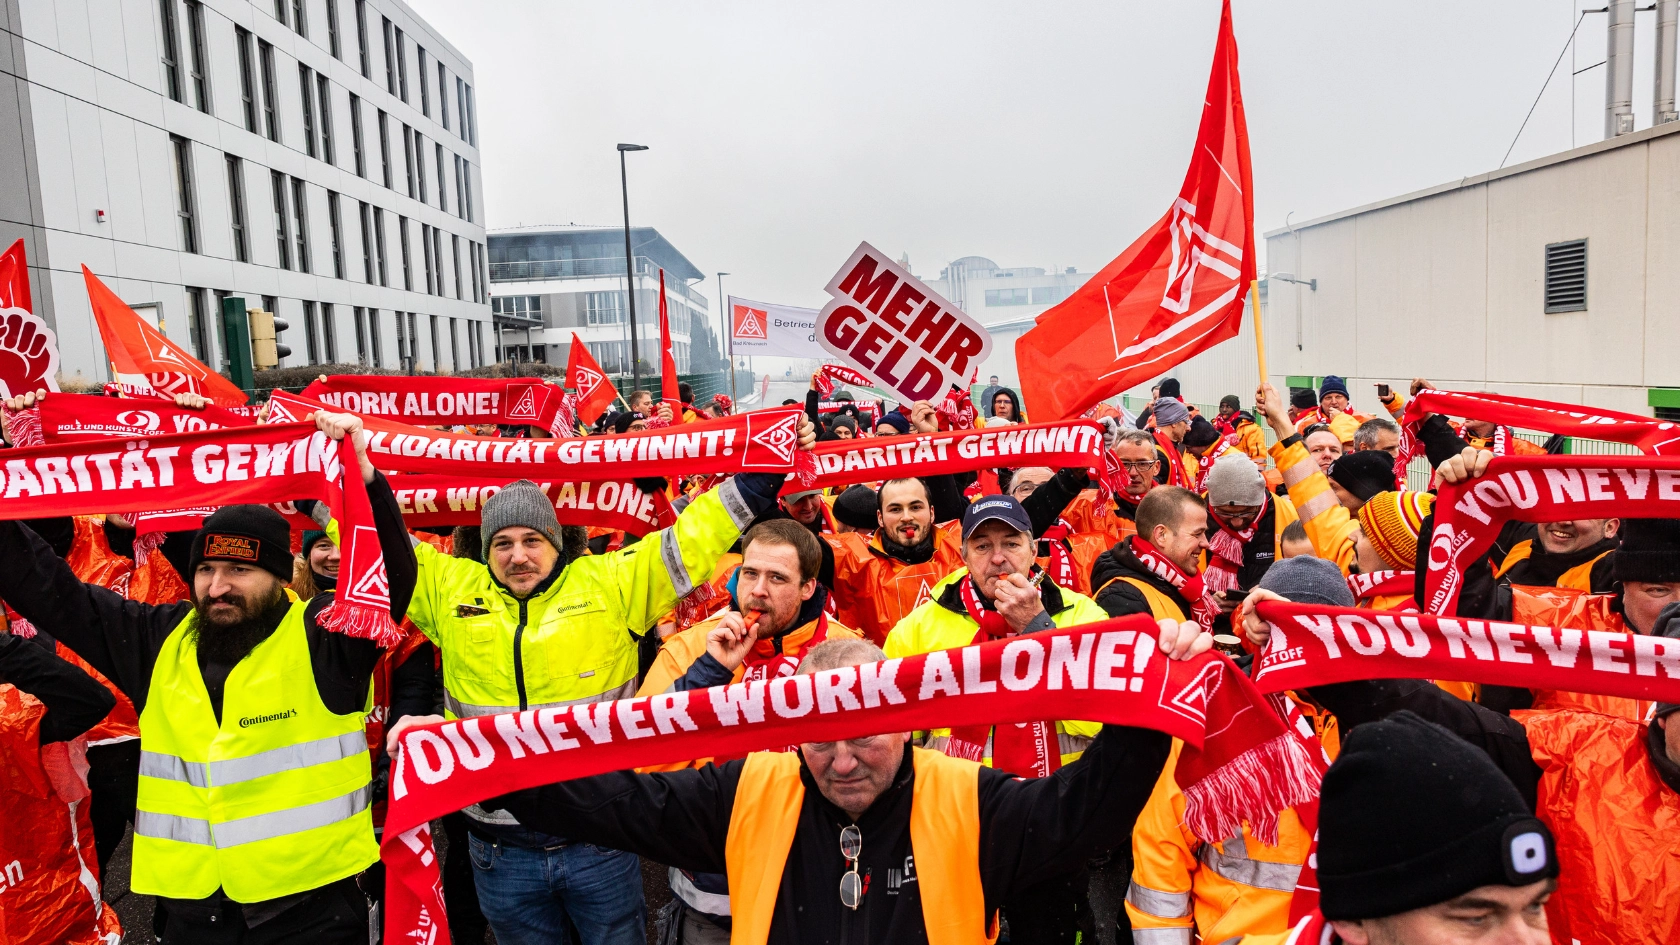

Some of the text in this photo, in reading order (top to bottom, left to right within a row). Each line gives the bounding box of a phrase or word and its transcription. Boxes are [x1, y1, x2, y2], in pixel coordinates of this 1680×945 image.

[838, 253, 983, 377] MEHR
[824, 305, 943, 400] GELD
[319, 392, 399, 416] WORK
[403, 391, 499, 415] ALONE!
[105, 425, 165, 435] KUNSTSTOFF
[957, 424, 1102, 459] GEWINNT!
[363, 428, 736, 464] LIDARITÄT GEWINNT!
[0, 431, 342, 498] ARITÄT GEWIN
[1455, 467, 1680, 525] YOU NEVE
[210, 544, 254, 557] ENFIELD
[214, 536, 250, 548] ROYAL
[558, 601, 588, 614] Continental
[1429, 591, 1446, 612] UND
[1293, 614, 1680, 680] YOU NEVER
[495, 691, 699, 760] NEVER
[708, 658, 906, 727] WORK
[918, 630, 1155, 701] ALONE!
[239, 709, 290, 729] Continental
[1035, 738, 1044, 759] UND
[1037, 759, 1046, 778] OLZ
